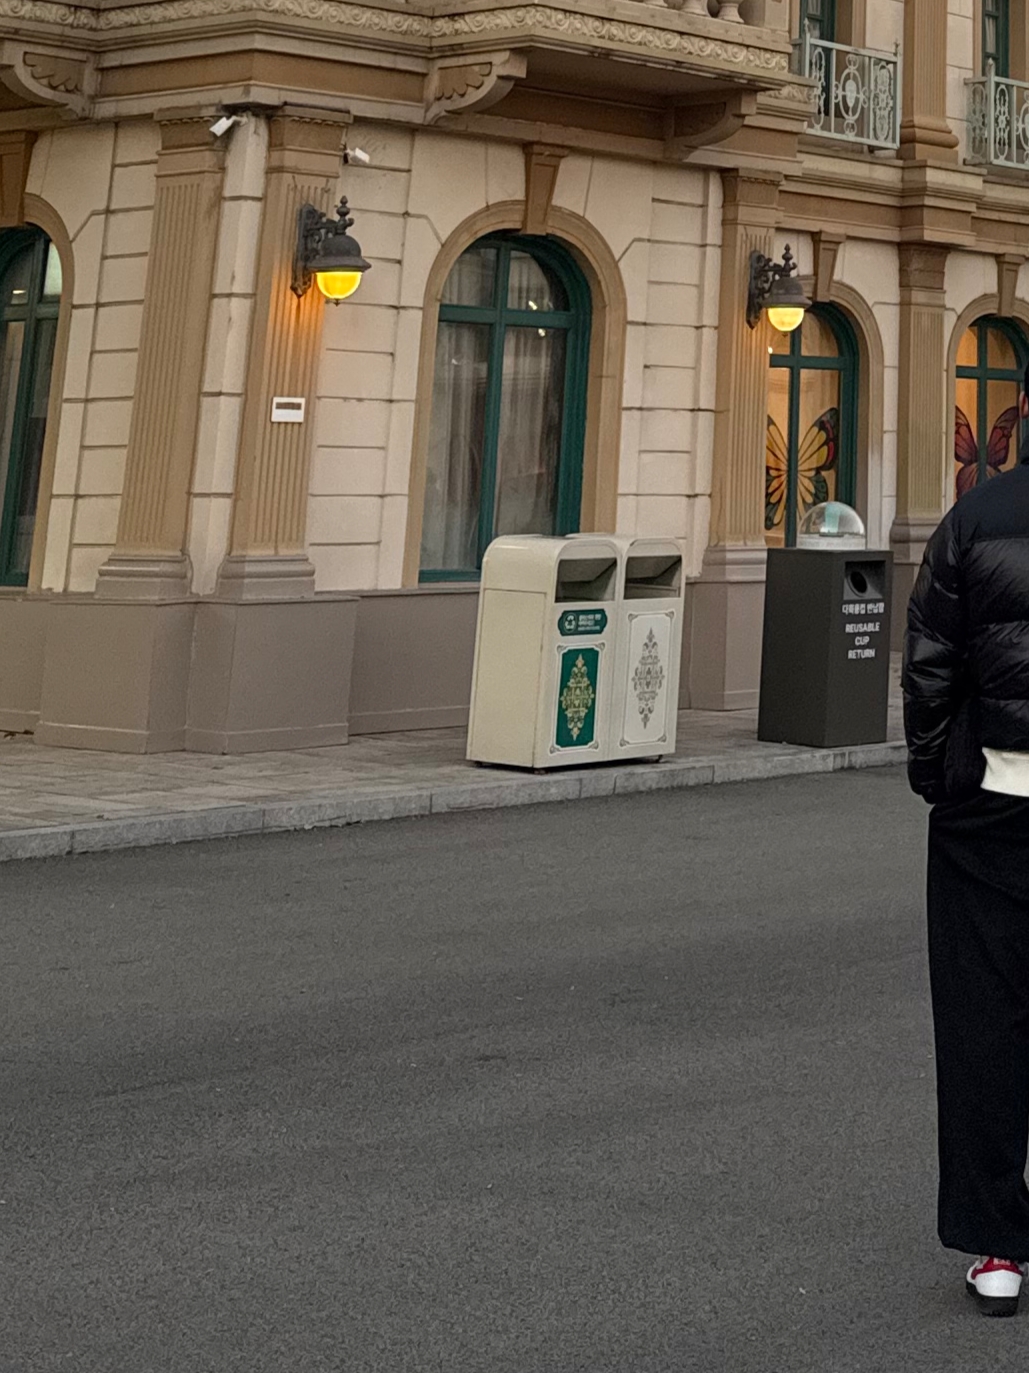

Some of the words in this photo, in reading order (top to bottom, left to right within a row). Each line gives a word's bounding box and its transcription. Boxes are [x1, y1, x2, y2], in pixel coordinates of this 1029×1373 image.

[845, 622, 880, 633] REUSABLE
[855, 636, 870, 646] CUP
[847, 648, 876, 659] RETURN
